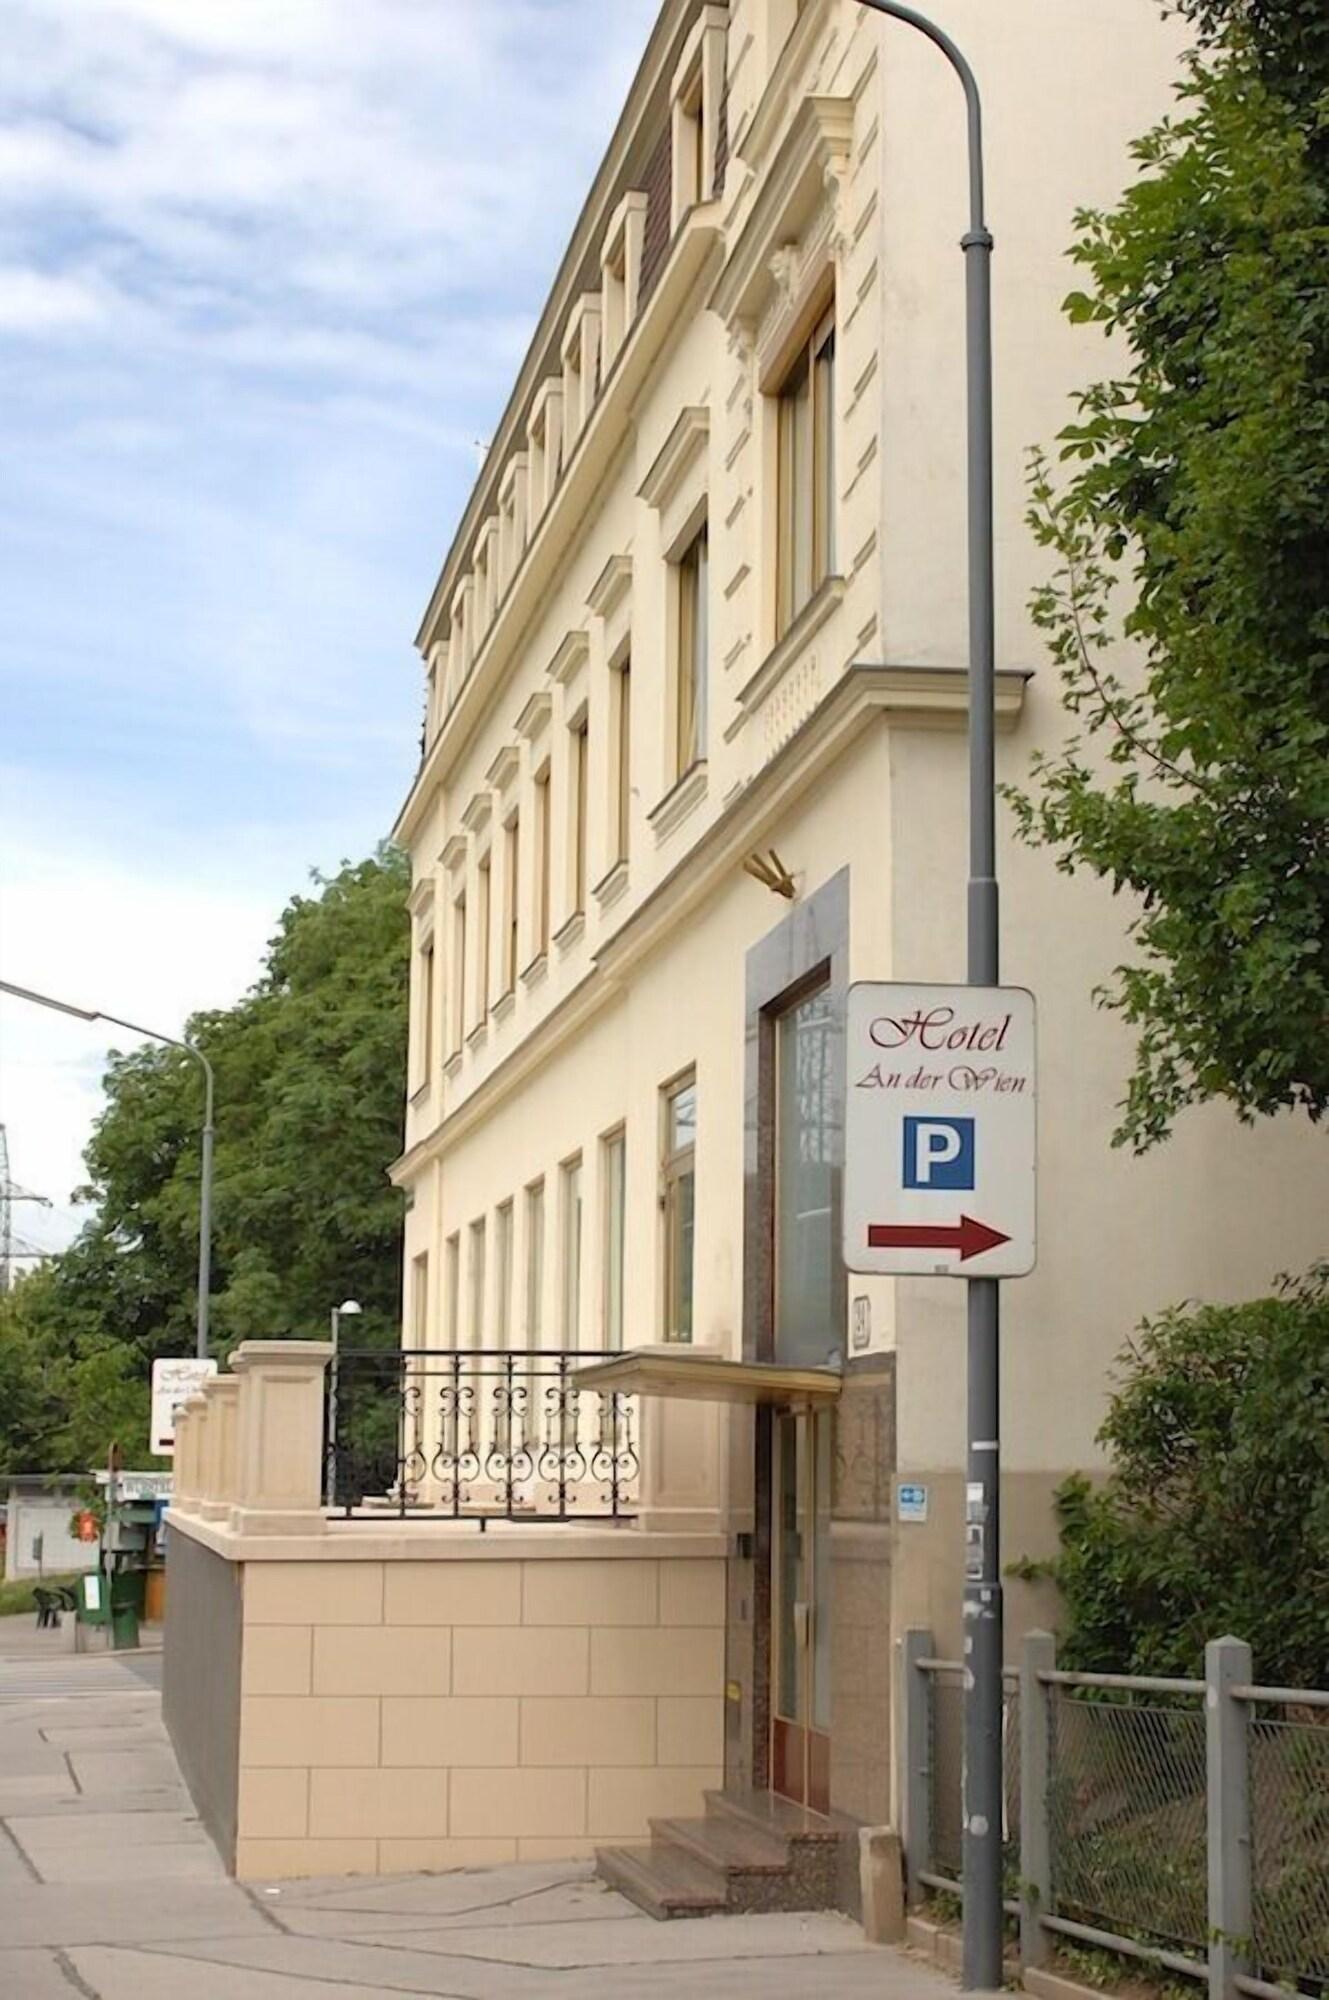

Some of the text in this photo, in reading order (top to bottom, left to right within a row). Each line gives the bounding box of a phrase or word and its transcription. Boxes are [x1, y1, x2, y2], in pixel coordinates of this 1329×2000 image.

[869, 1006, 1012, 1051] Hotel
[855, 1063, 1027, 1092] An der Wien
[915, 1123, 962, 1183] P
